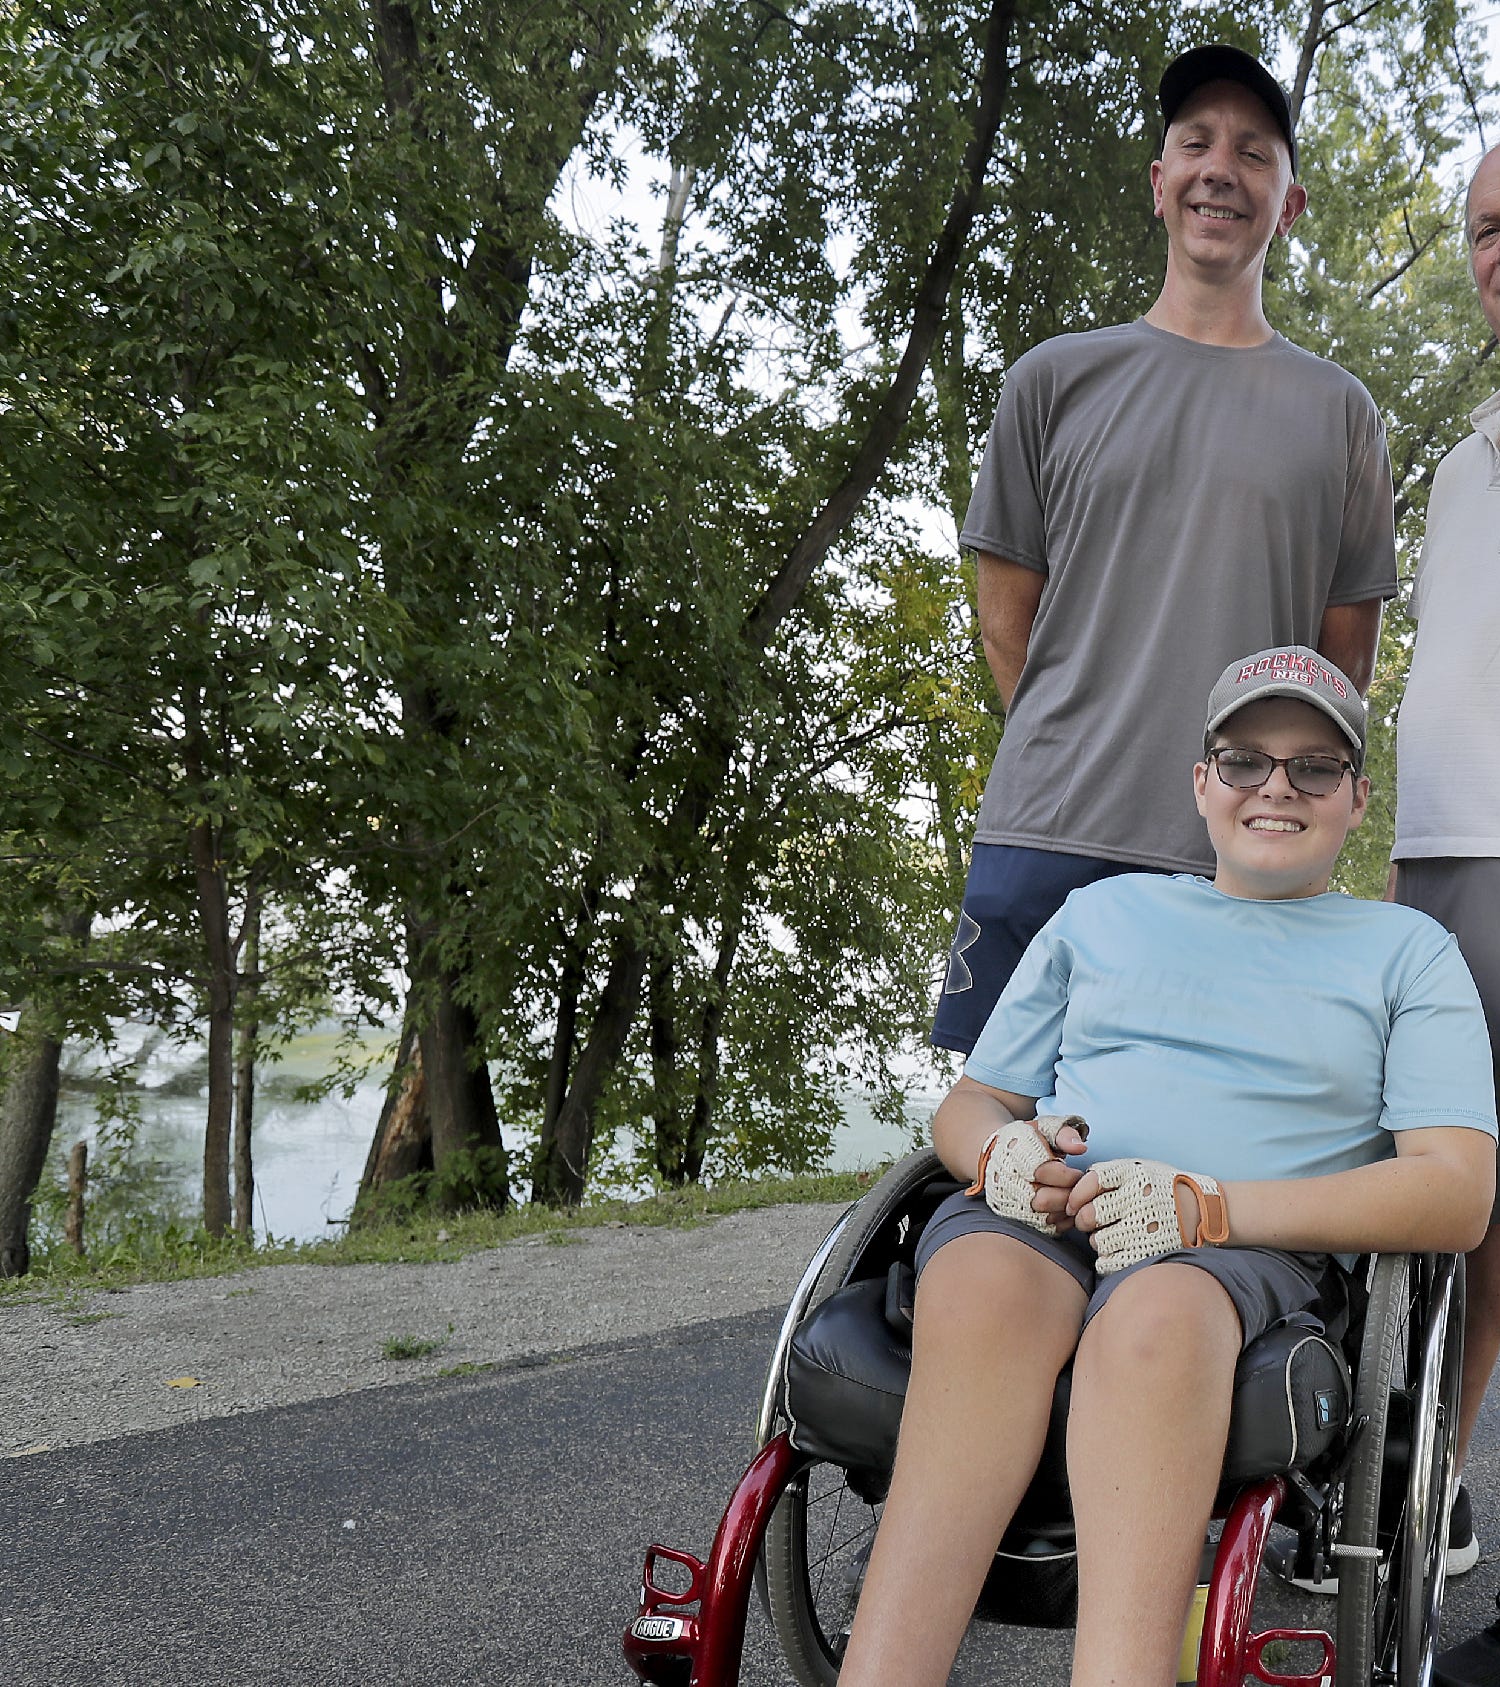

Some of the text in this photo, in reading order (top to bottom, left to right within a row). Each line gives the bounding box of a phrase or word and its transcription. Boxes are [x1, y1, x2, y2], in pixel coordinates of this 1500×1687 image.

[1236, 653, 1348, 699] ROCKETS
[1274, 669, 1312, 684] NHS
[637, 1619, 674, 1637] ROGUE
